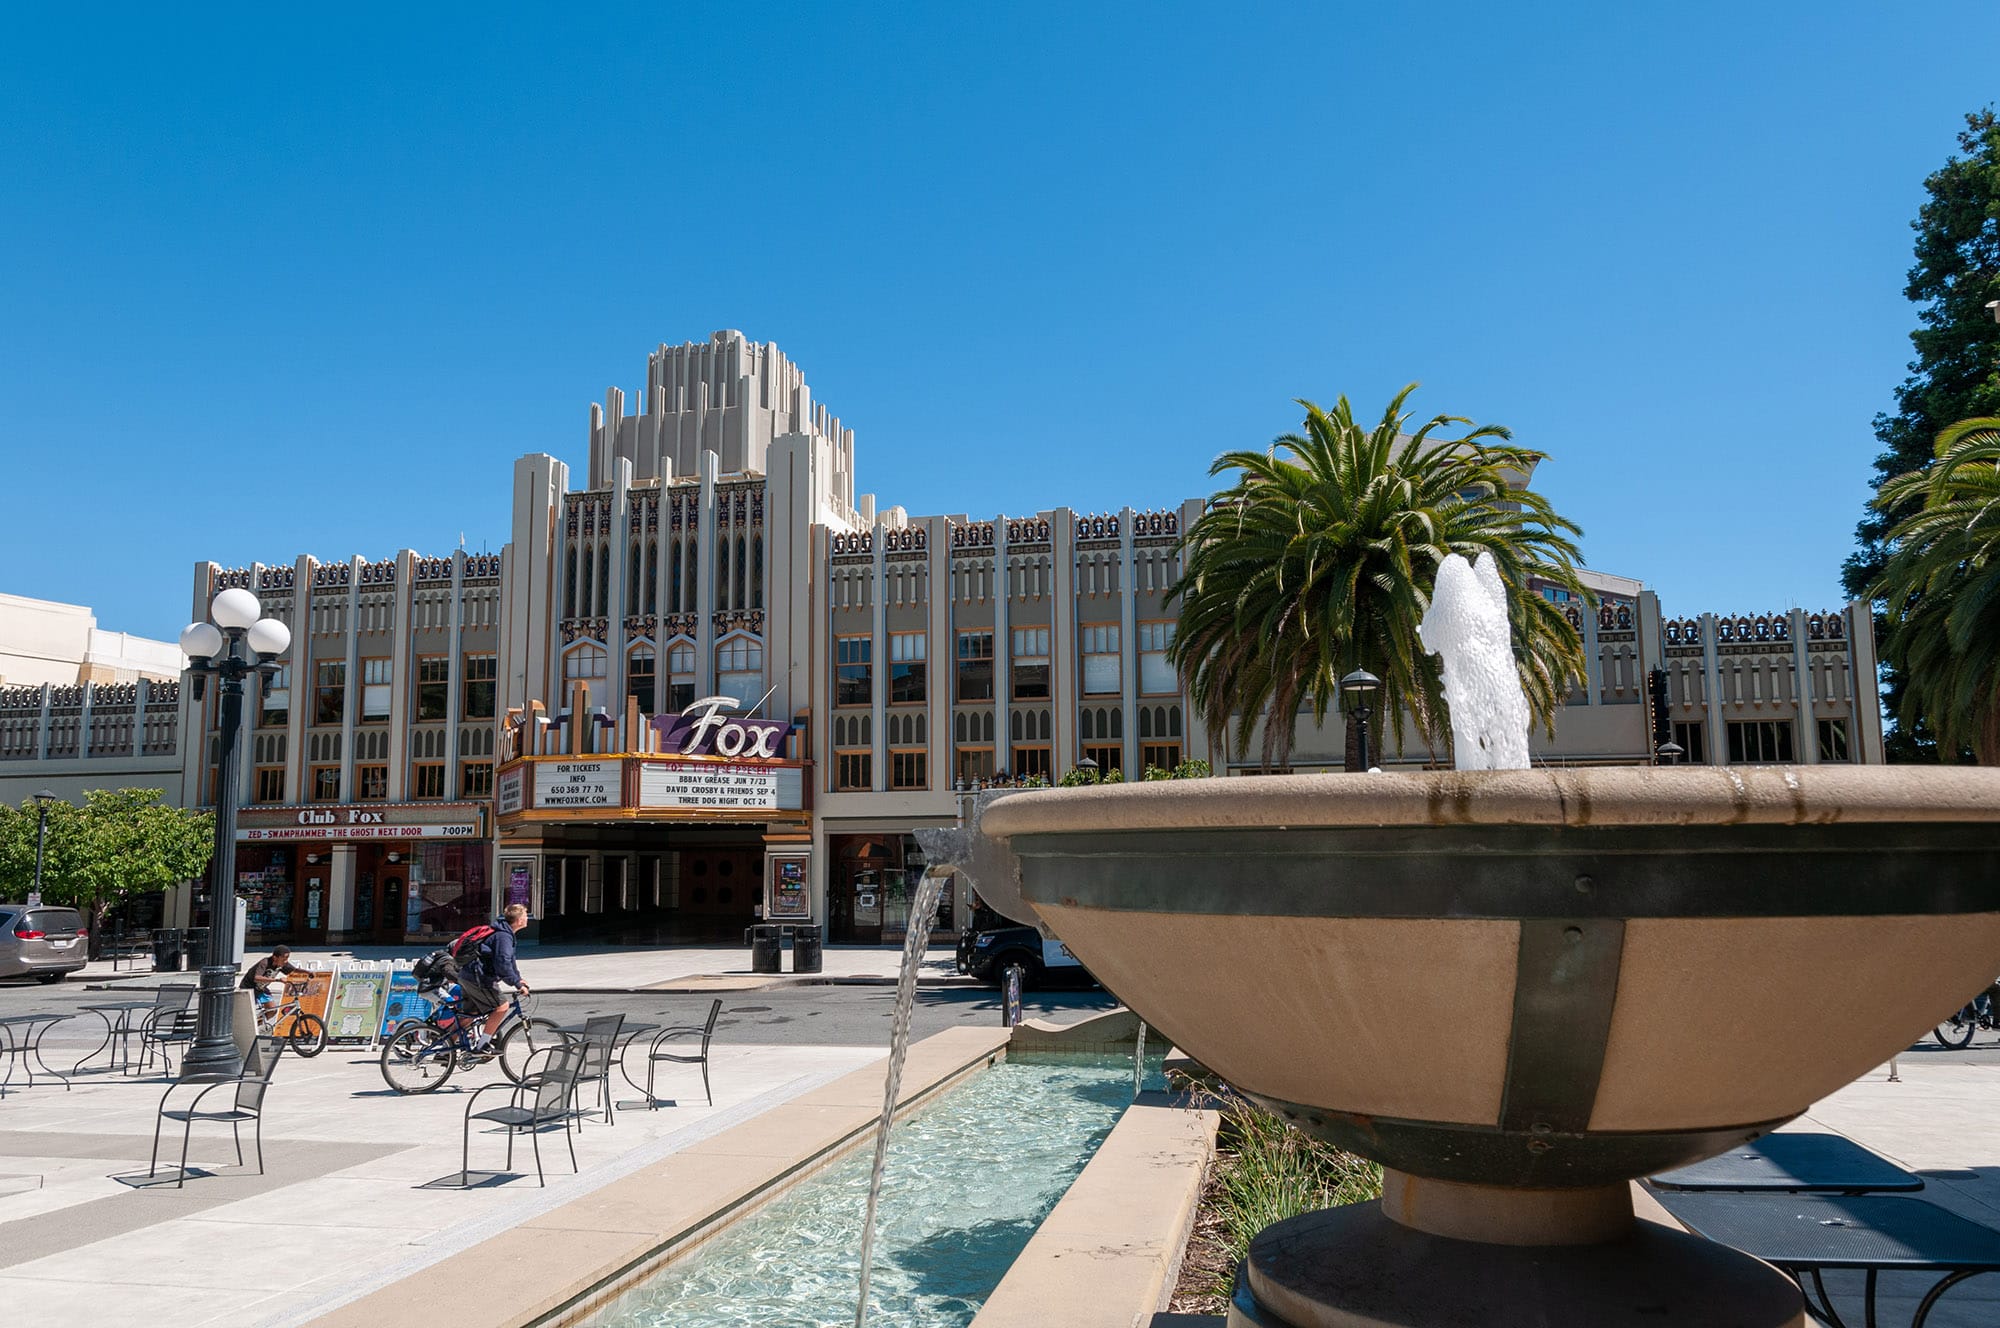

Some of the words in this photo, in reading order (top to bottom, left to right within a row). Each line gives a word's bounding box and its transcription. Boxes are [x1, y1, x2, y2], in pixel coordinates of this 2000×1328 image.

[681, 696, 780, 758] Fox
[573, 764, 600, 772] TICKETS
[570, 775, 586, 783] INFO
[705, 776, 730, 784] GREASE
[734, 777, 746, 785] JUN
[551, 786, 565, 794] 650
[582, 785, 591, 793] 77
[594, 785, 604, 793] 70
[692, 786, 718, 794] CROSBY
[727, 787, 753, 795] FRIENDS
[679, 796, 699, 804] THREE
[719, 797, 738, 805] NIGHT
[298, 809, 335, 824] Club
[348, 809, 384, 824] Fox
[350, 828, 375, 837] GHOST
[378, 828, 398, 836] NEXT
[401, 827, 422, 836] DOOR
